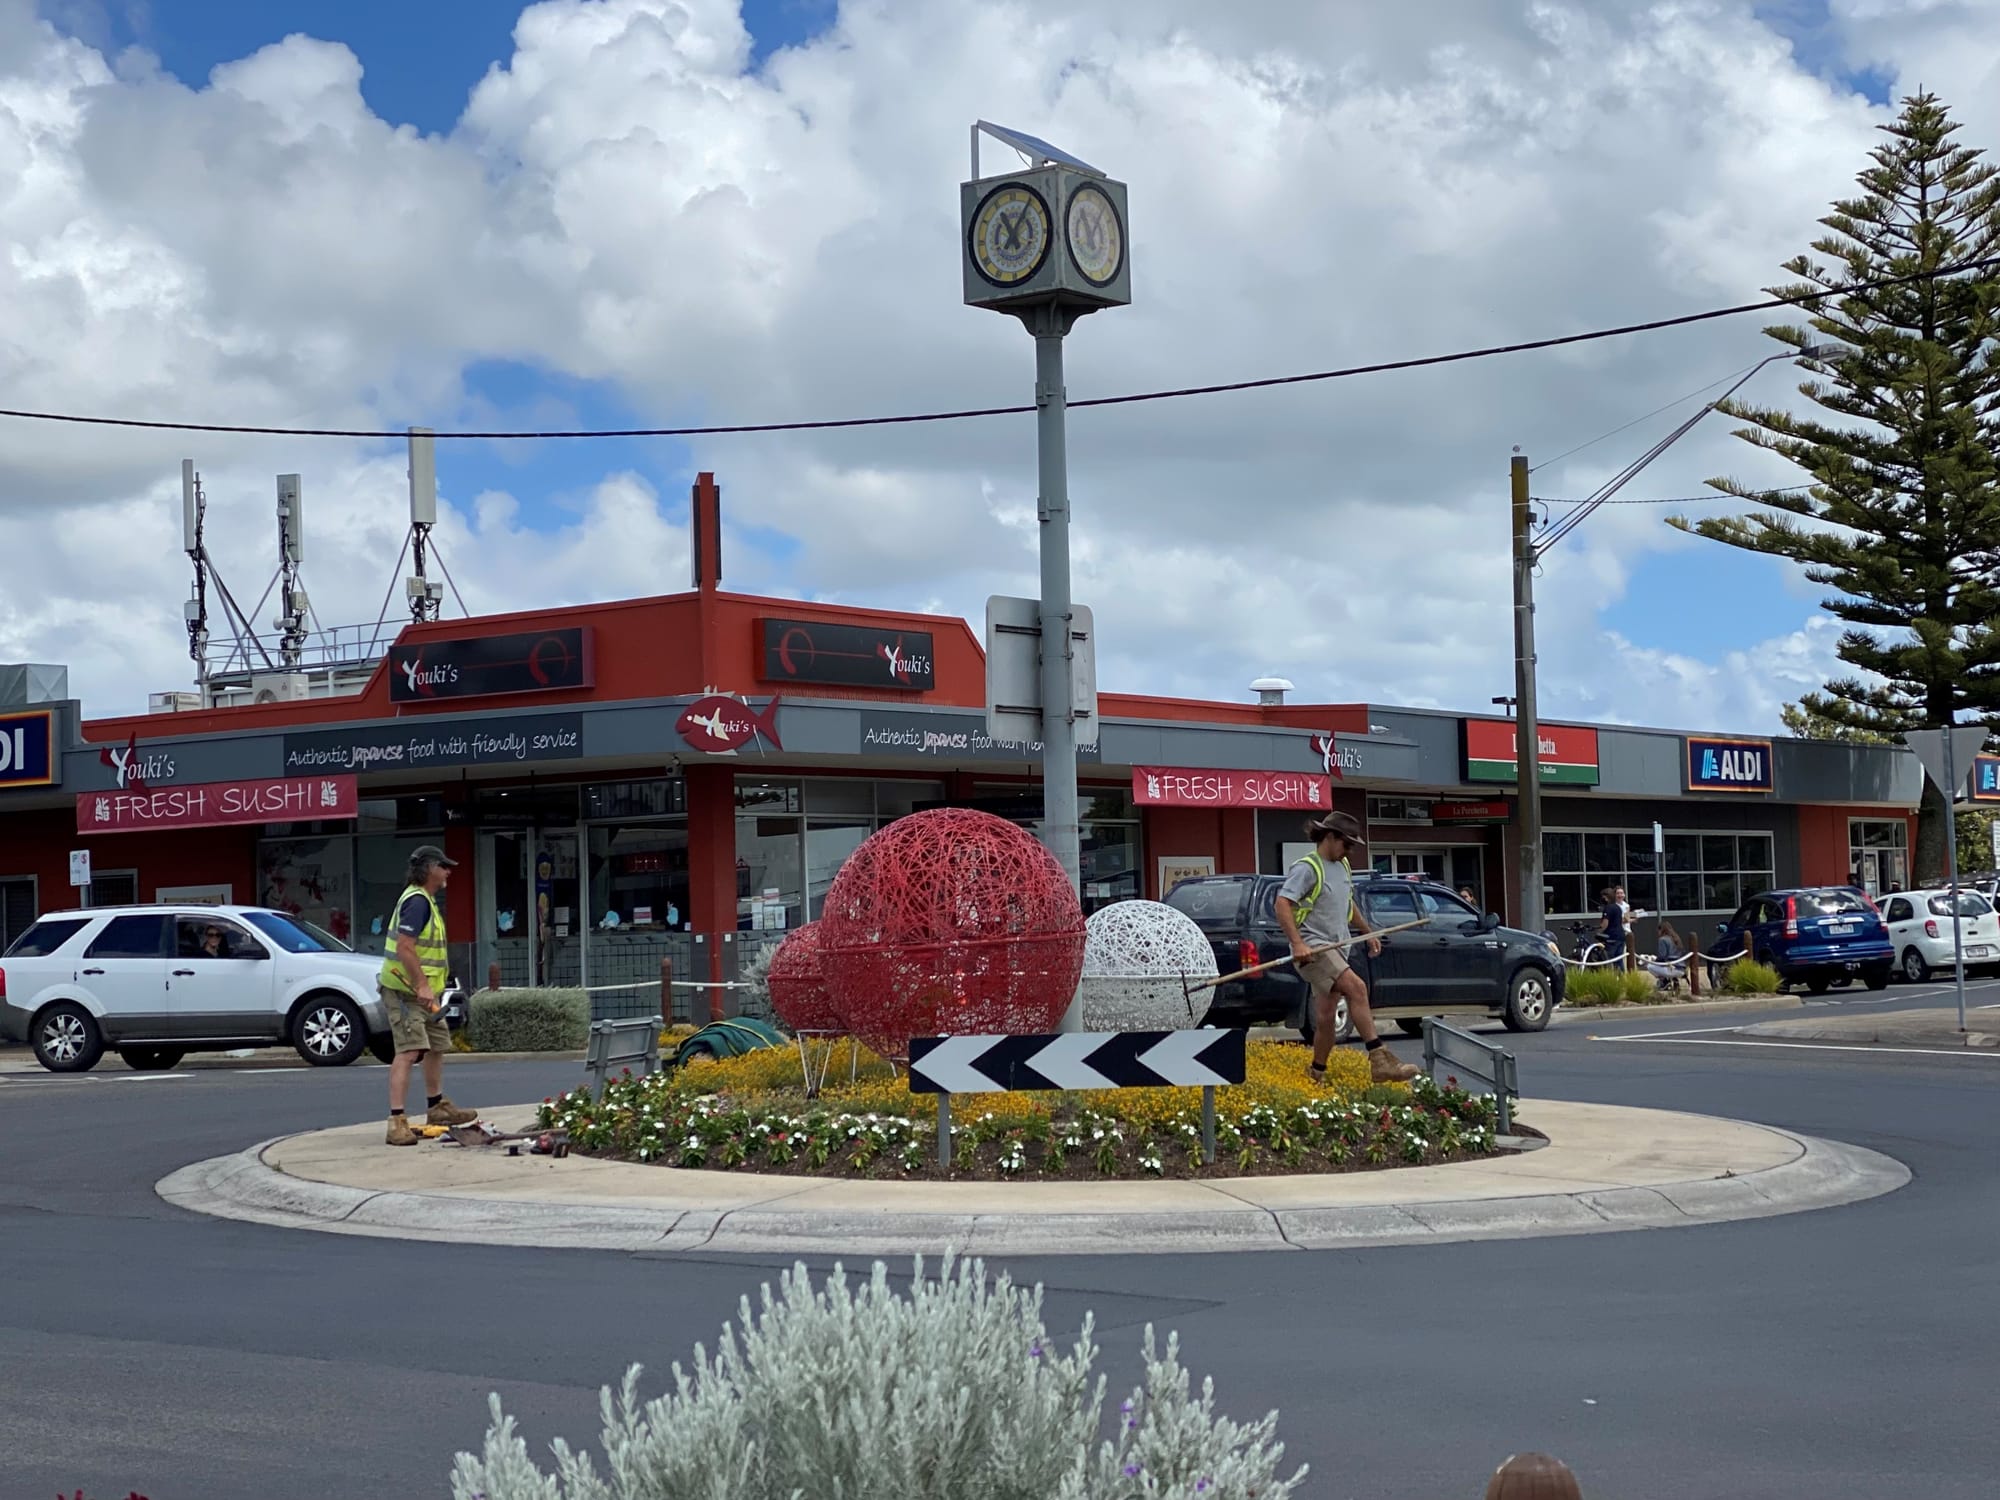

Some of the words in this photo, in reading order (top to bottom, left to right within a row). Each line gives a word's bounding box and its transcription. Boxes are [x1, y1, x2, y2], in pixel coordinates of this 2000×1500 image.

[402, 659, 459, 692] Youki's
[884, 645, 930, 678] Youki's
[286, 745, 348, 766] Authentic
[407, 738, 434, 764] food
[439, 736, 467, 755] with
[471, 733, 526, 759] friendly
[532, 728, 577, 749] service
[864, 728, 920, 745] Authentic
[110, 748, 175, 788] Youki's
[1319, 736, 1362, 773] Youki's
[1721, 749, 1762, 782] ALDI
[114, 790, 206, 823] FRESH
[219, 783, 312, 814] SUSHI
[1163, 776, 1232, 801] FRESH
[1243, 779, 1304, 803] SUSHI
